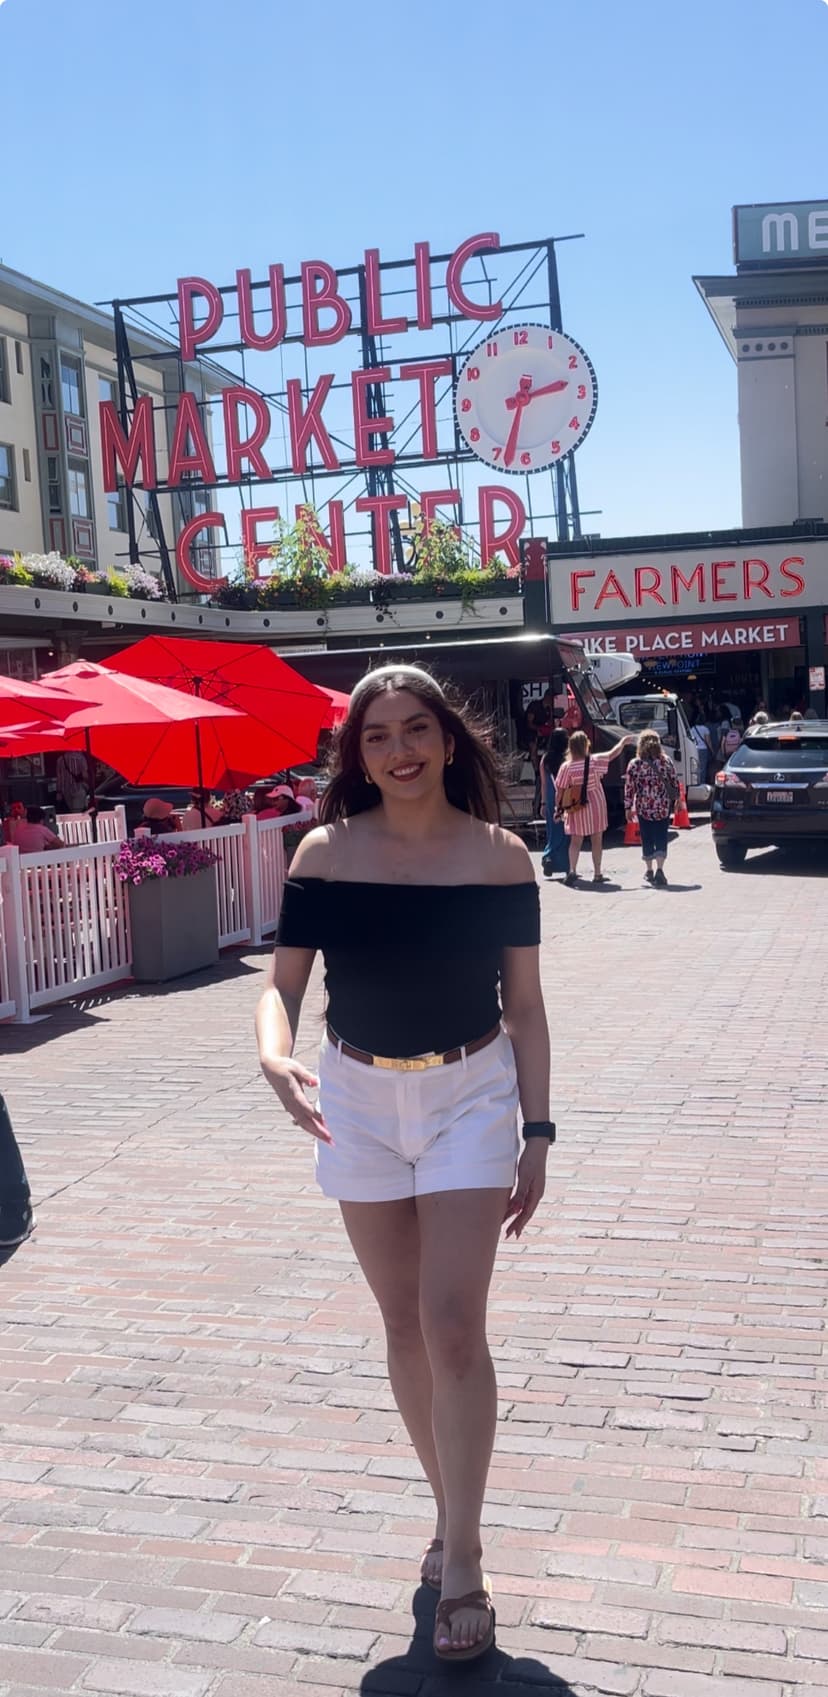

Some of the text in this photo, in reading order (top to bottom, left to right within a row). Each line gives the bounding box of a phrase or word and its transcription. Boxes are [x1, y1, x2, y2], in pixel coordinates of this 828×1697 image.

[177, 232, 502, 361] PUBLIC
[514, 331, 528, 345] 12
[548, 336, 553, 350] 1
[487, 342, 498, 357] 11
[568, 355, 578, 369] 2
[467, 367, 480, 381] 10
[577, 385, 586, 399] 3
[461, 398, 472, 412] 9
[99, 359, 453, 492] MARKET
[568, 416, 580, 430] 4
[470, 427, 480, 442] 8
[492, 447, 502, 461] 7
[551, 441, 560, 454] 5
[520, 452, 531, 465] 6
[570, 556, 806, 611] FARMERS
[582, 624, 789, 653] IKE PLACE MARKET
